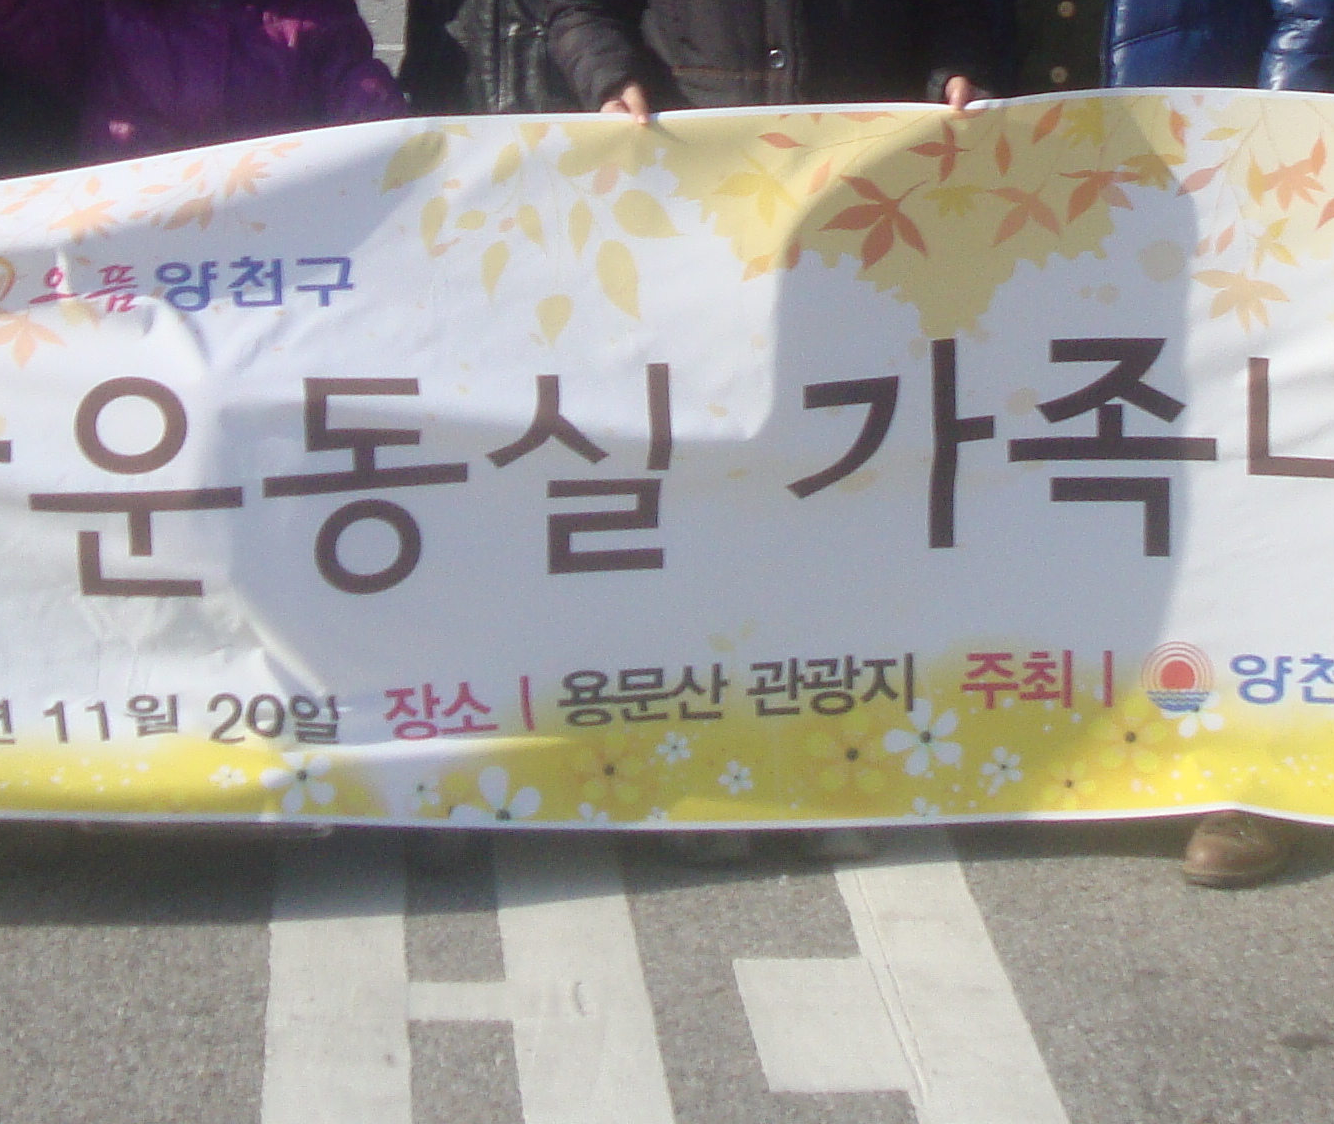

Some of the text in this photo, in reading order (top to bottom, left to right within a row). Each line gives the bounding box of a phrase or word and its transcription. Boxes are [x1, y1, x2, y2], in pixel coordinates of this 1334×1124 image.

[154, 255, 356, 313] 양천구
[43, 692, 180, 744] 11월
[207, 691, 342, 747] 20일
[383, 681, 500, 743] 장소
[557, 663, 730, 728] 용문산
[744, 652, 916, 718] 관광지
[960, 649, 1074, 711] 주최
